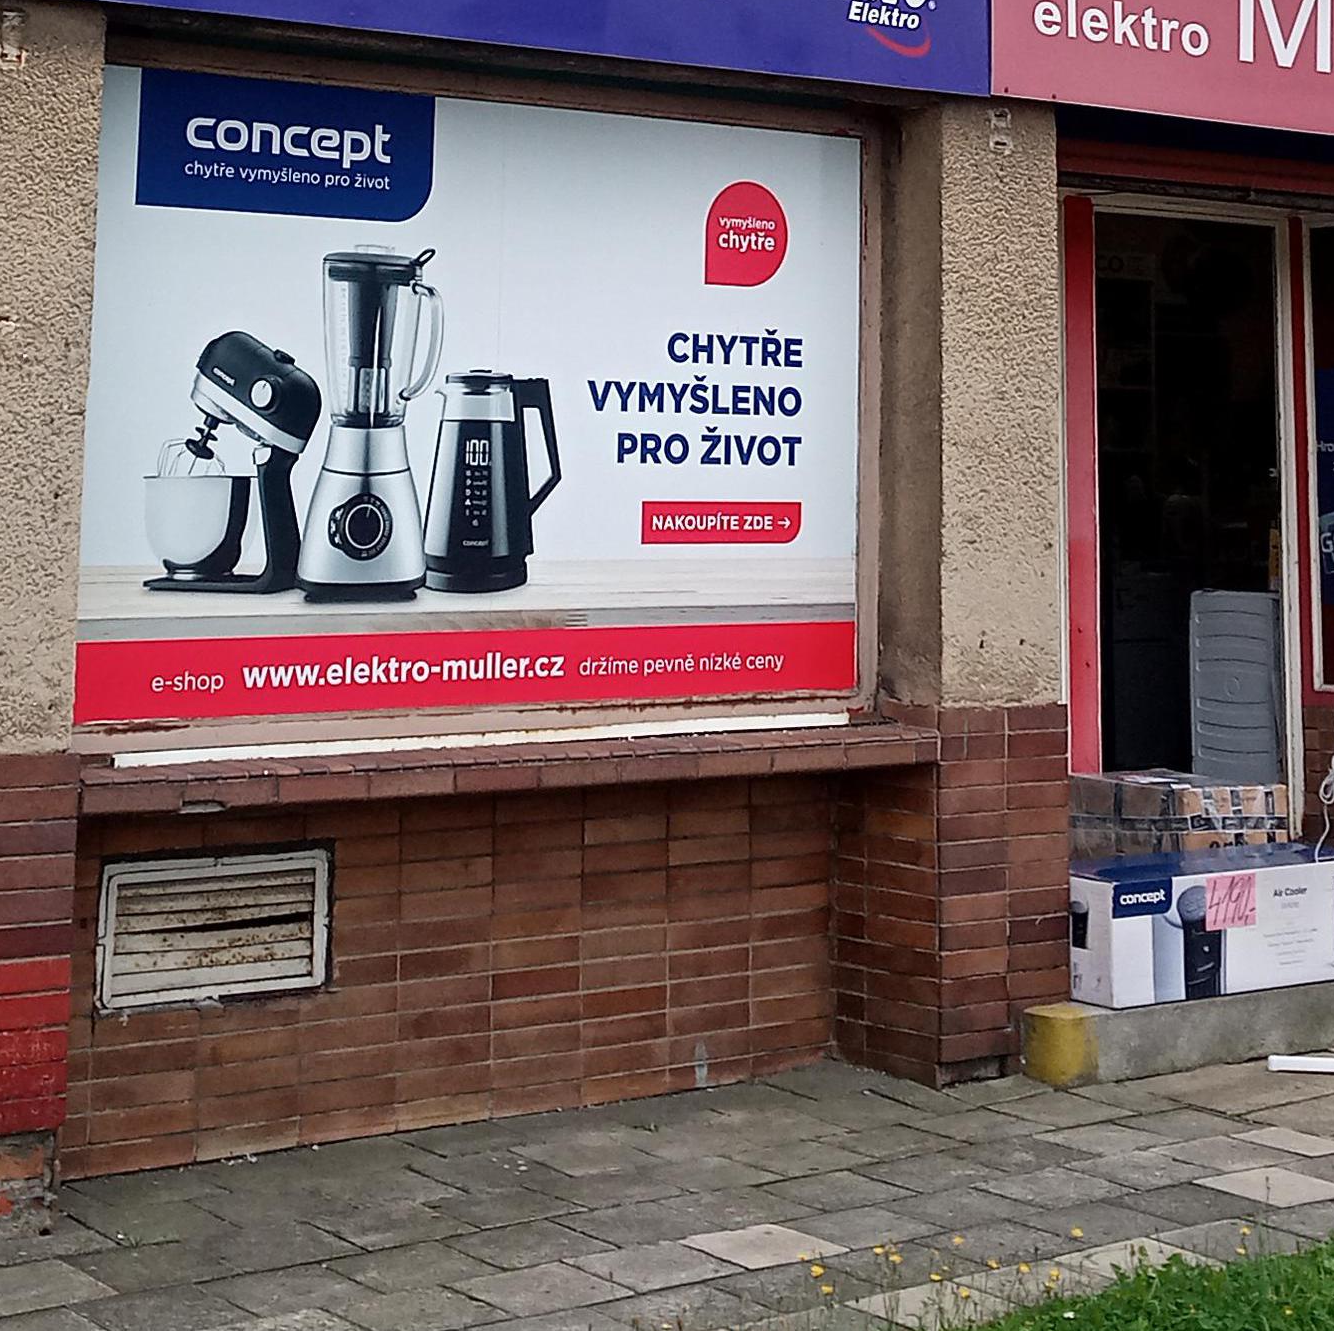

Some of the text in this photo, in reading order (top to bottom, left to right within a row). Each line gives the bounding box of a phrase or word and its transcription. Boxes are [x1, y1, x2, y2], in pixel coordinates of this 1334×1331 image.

[186, 116, 392, 169] concept
[184, 160, 391, 191] chytře vymyšleno pro život
[718, 215, 776, 232] vymyšleno
[718, 231, 776, 253] chytře
[666, 328, 804, 369] CHYTŘE
[586, 374, 803, 417] VYMYŠLENO
[616, 425, 803, 467] PRO ŽIVOT
[651, 510, 774, 532] NAKOUPÍTE ZDE
[151, 652, 785, 694] e-shop www.elektro-muller.cz držíme pevně nízké ceny
[1120, 889, 1166, 905] concept
[1284, 887, 1307, 897] Cooler
